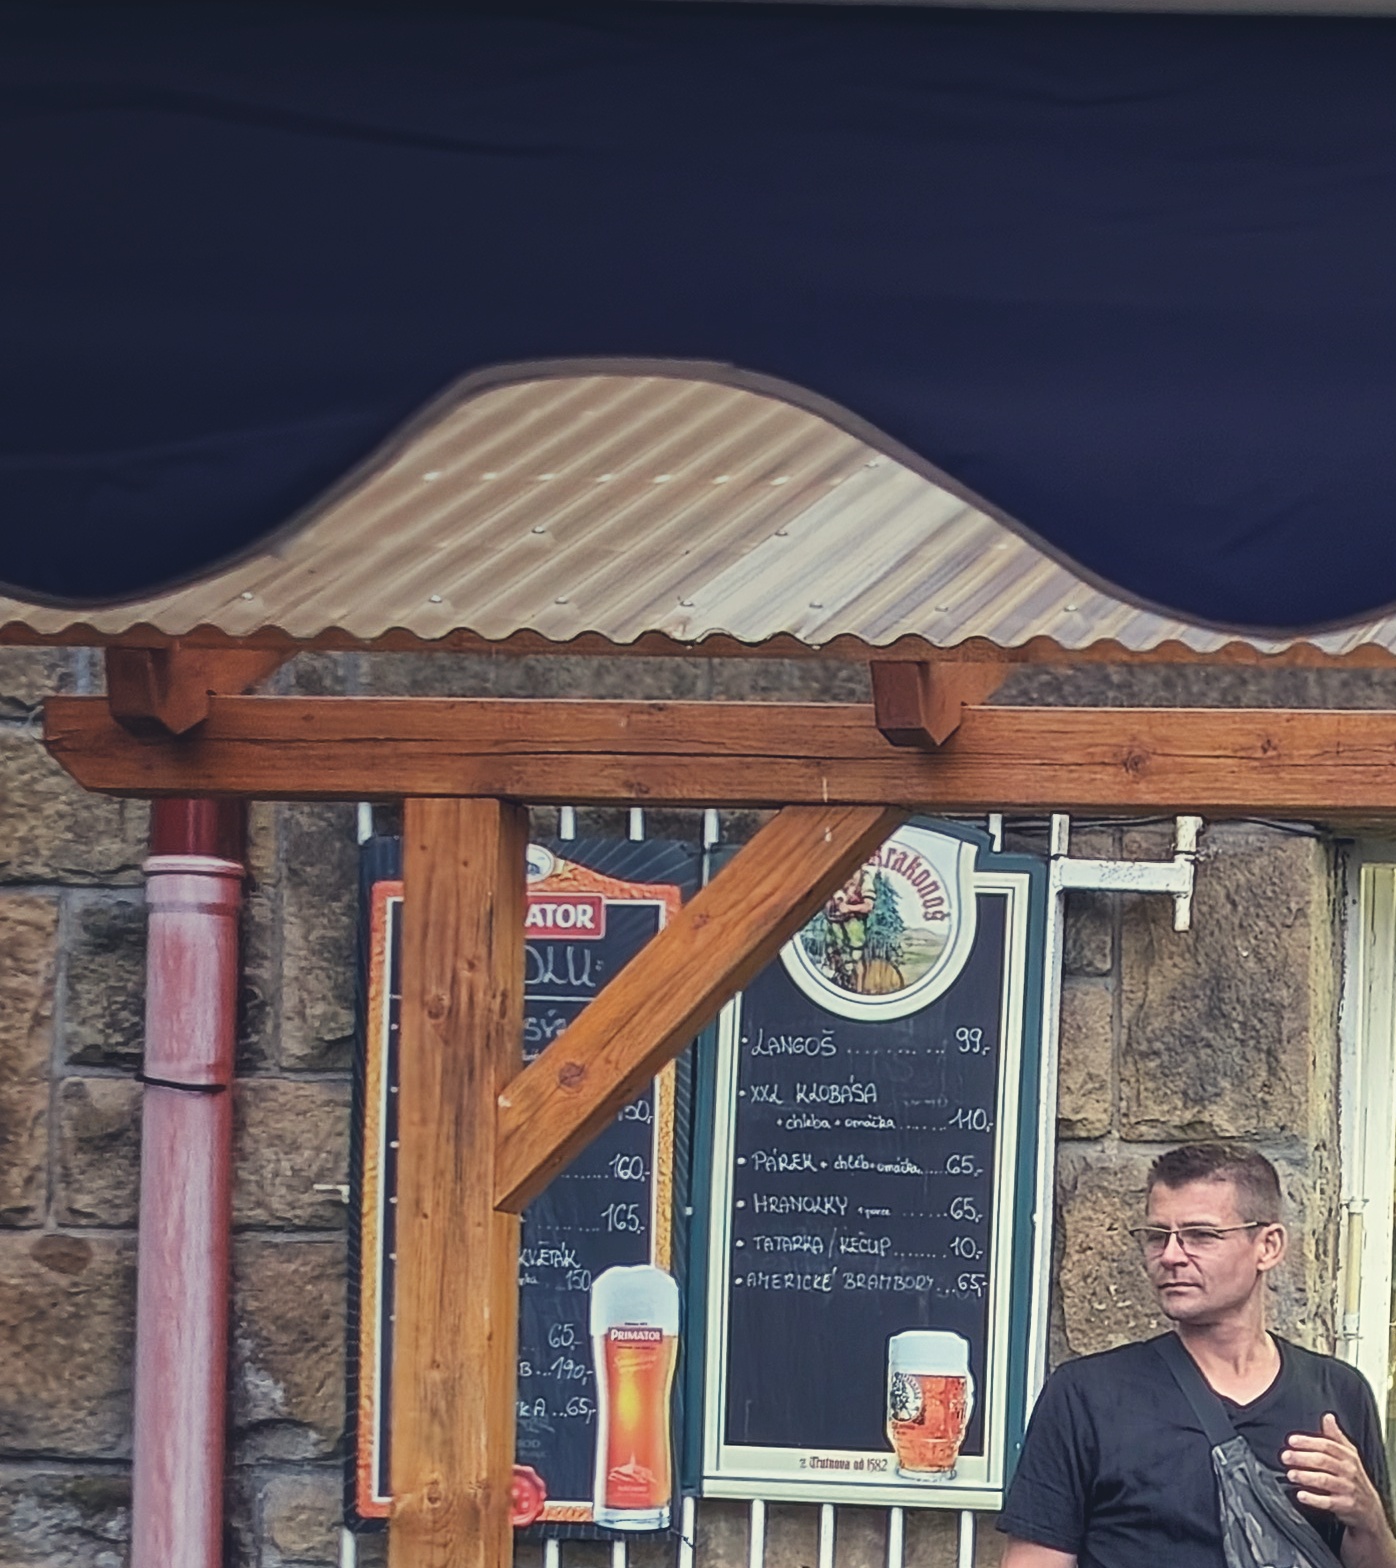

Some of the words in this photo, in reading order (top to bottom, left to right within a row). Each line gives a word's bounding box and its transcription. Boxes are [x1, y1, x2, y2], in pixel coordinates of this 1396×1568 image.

[872, 846, 951, 921] rakonoš
[526, 904, 594, 929] ATOR
[751, 1029, 837, 1056] LANGOŠ
[750, 1085, 784, 1104] XXL
[796, 1075, 878, 1104] KLOBÁSA
[752, 1148, 817, 1172] PÁREK
[753, 1193, 848, 1215] HRANOLKY
[753, 1235, 823, 1254] TATARKA
[840, 1231, 891, 1256] KEČUP
[747, 1266, 837, 1291] AMERICKÉ
[843, 1274, 933, 1291] BRAMBORY
